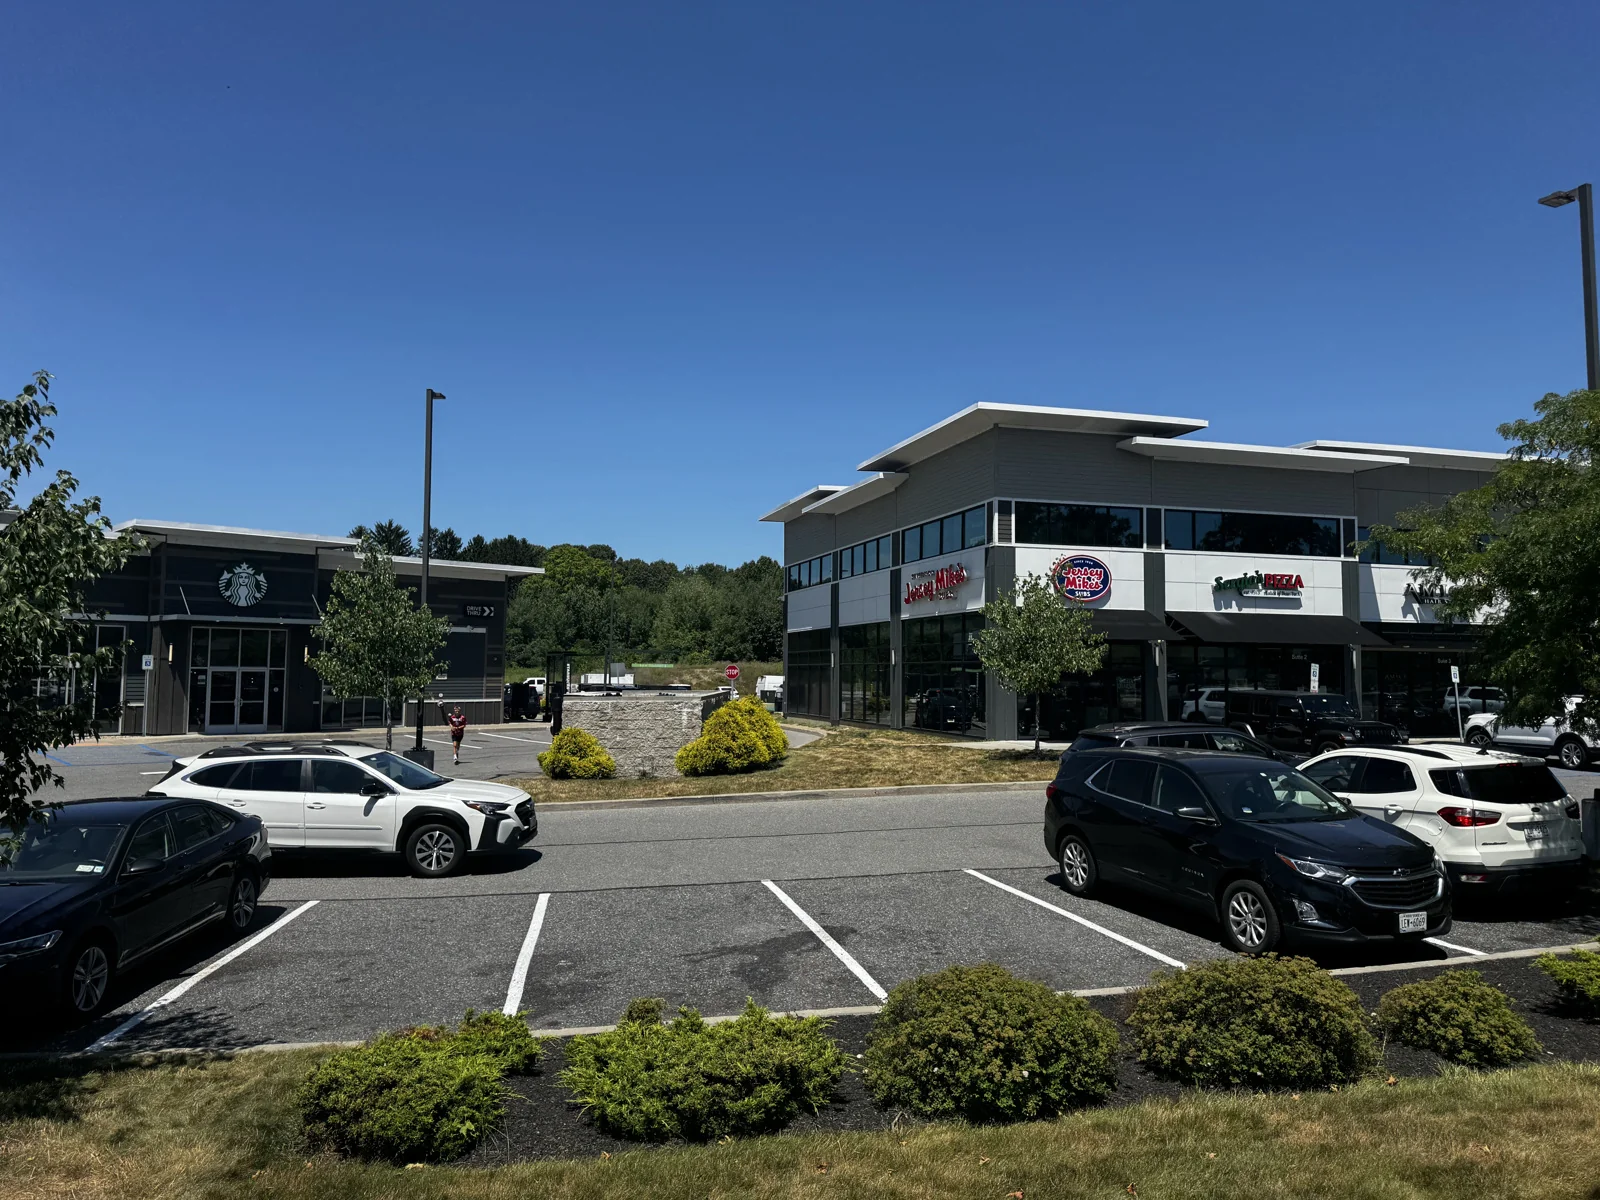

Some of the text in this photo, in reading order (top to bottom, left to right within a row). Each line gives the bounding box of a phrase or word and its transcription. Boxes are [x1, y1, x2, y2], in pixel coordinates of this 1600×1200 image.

[1062, 566, 1104, 580] Jersey
[904, 562, 967, 604] Jersey Mike's
[1065, 576, 1104, 590] Mike's
[1264, 573, 1305, 588] PIZZA
